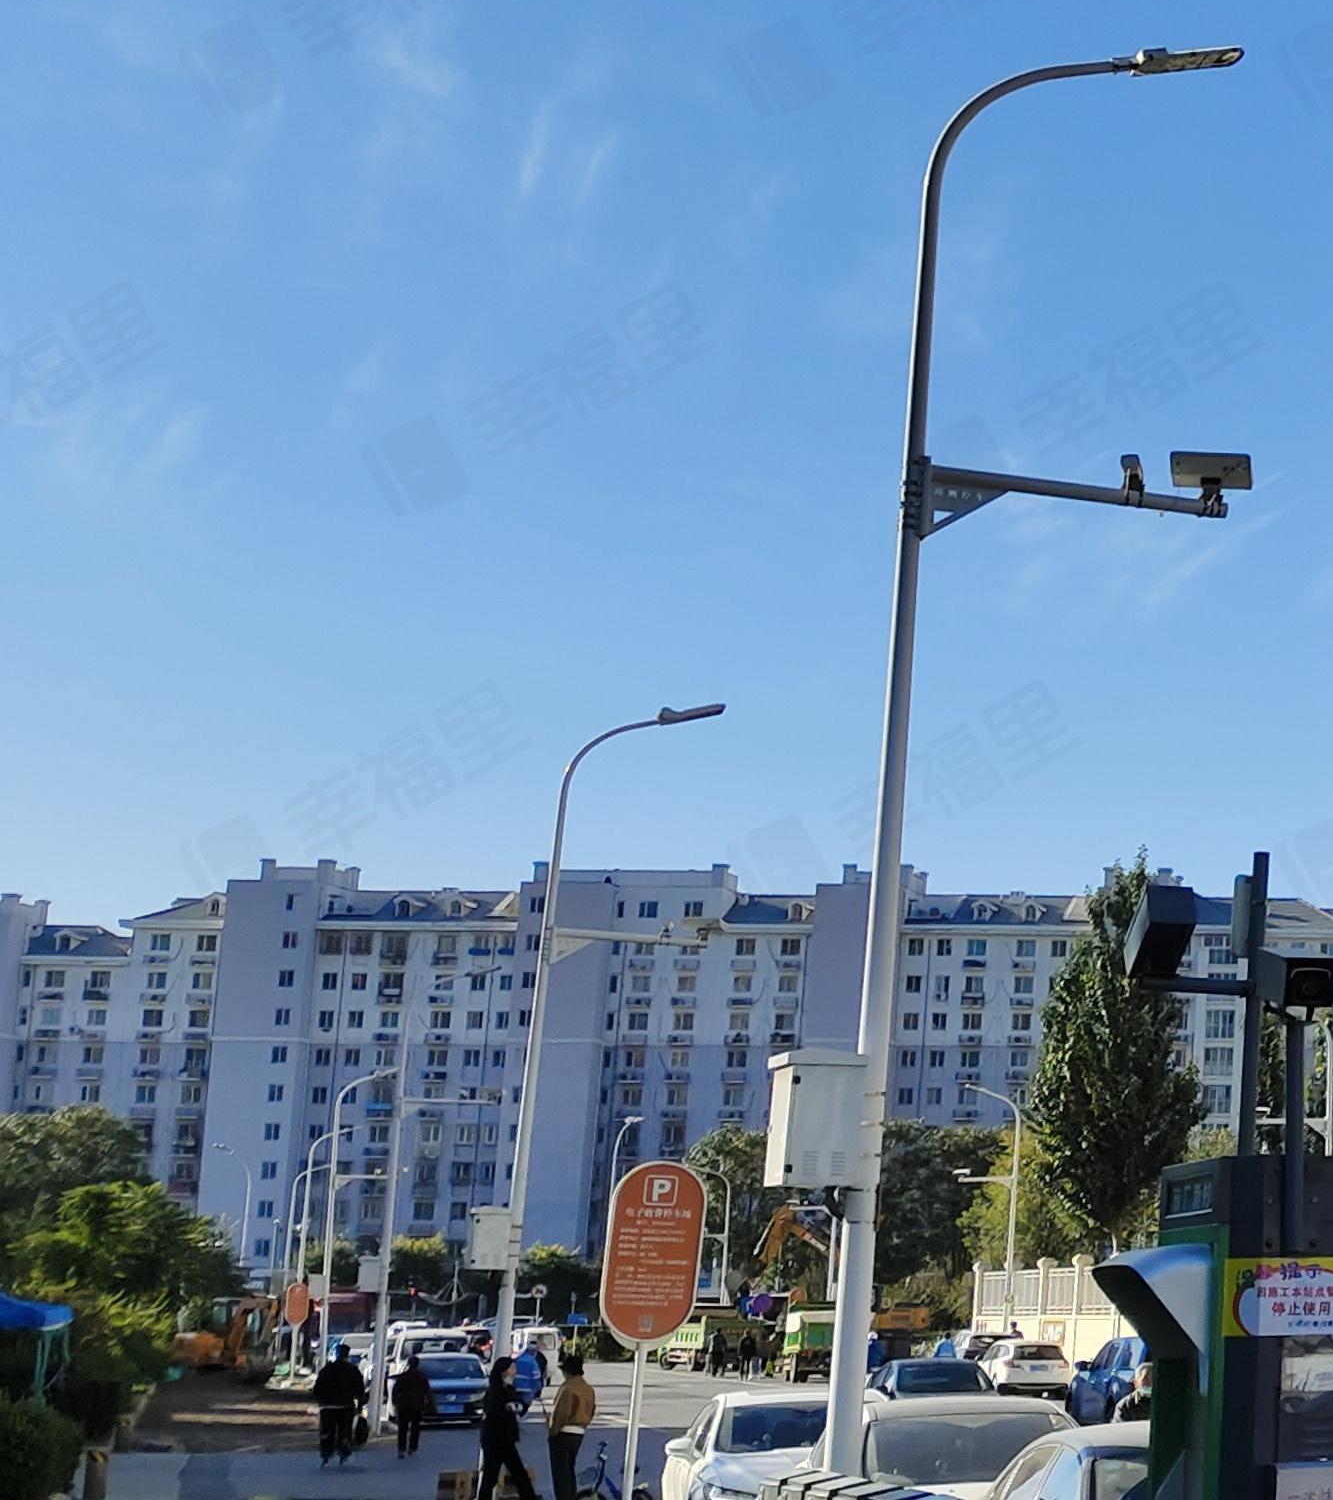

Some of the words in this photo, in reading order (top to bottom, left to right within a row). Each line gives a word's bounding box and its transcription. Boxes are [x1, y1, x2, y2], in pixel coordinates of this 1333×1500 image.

[651, 1179, 672, 1202] P
[1271, 1301, 1331, 1316] 停止使用
